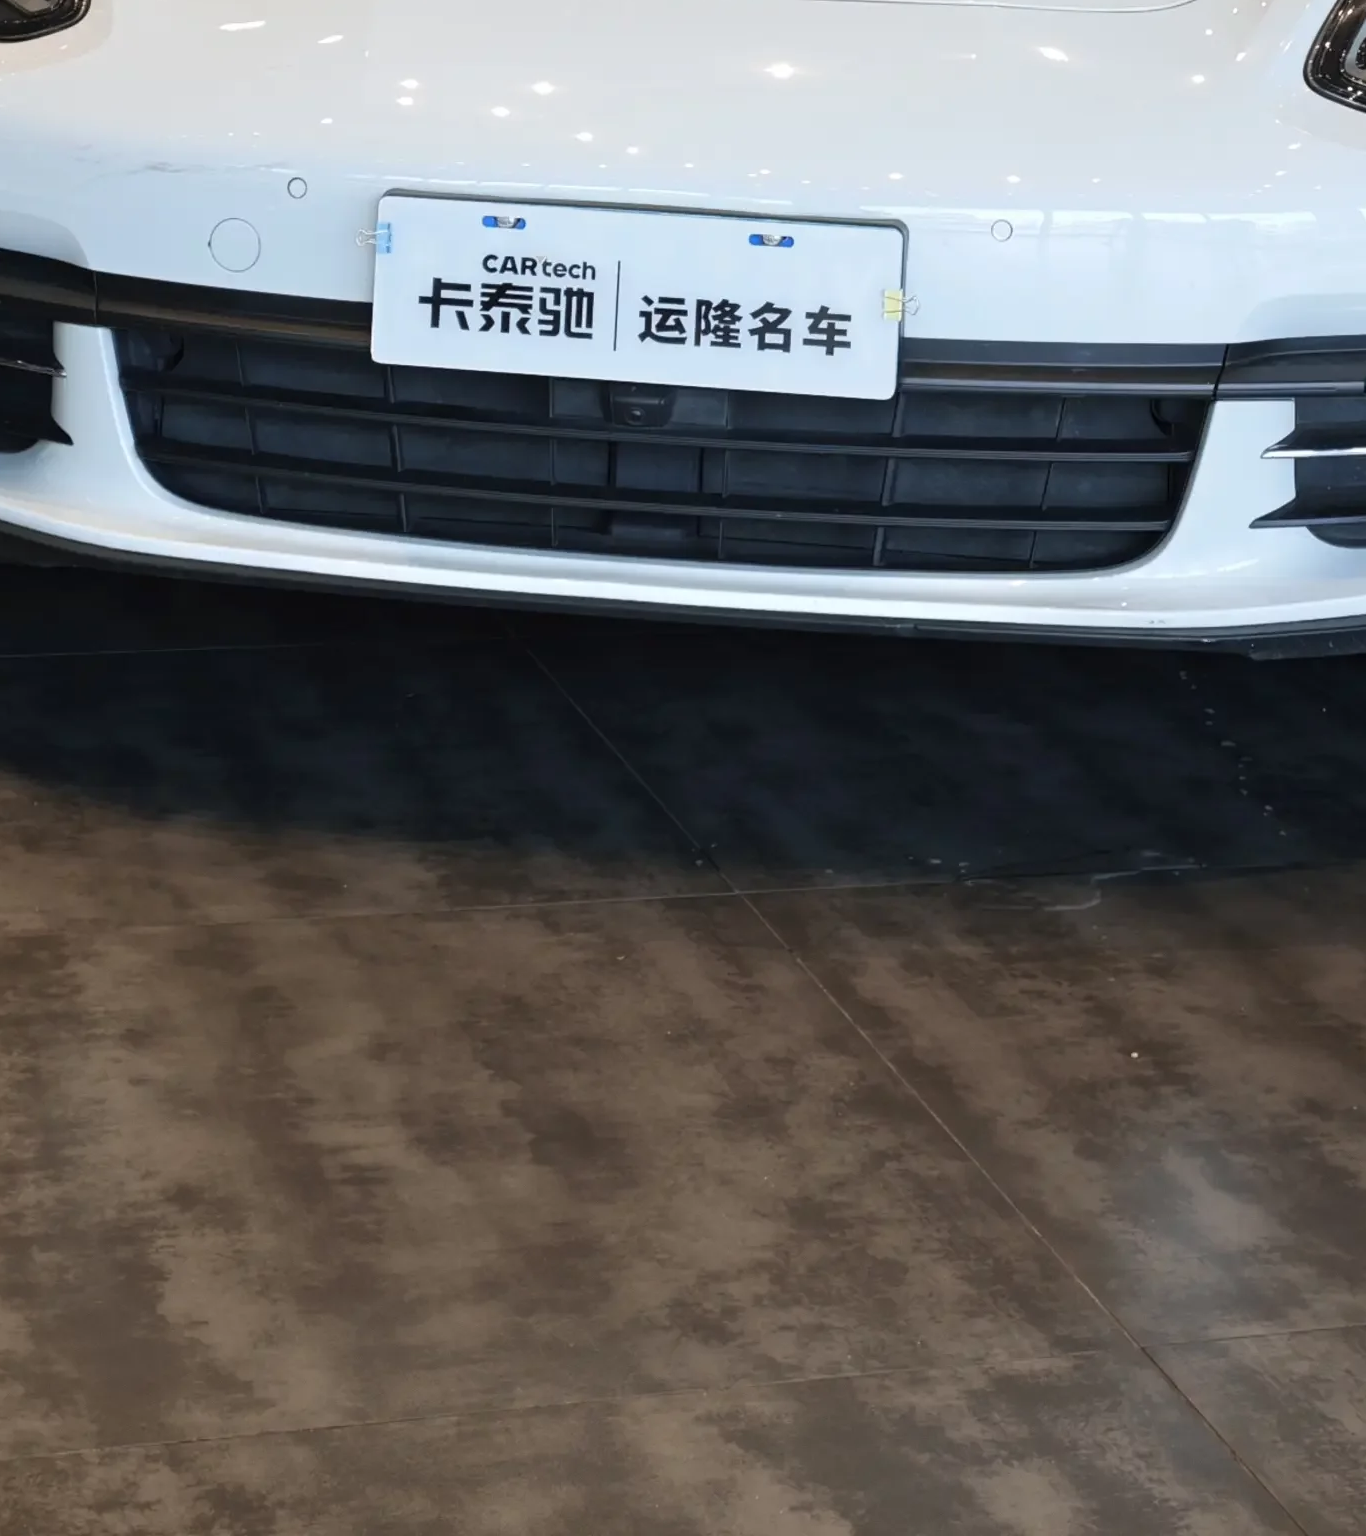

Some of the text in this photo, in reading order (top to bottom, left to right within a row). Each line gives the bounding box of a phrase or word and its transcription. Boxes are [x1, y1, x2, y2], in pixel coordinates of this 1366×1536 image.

[481, 253, 596, 281] CARtech
[418, 277, 852, 356] 卡泰驰 运隆名车
